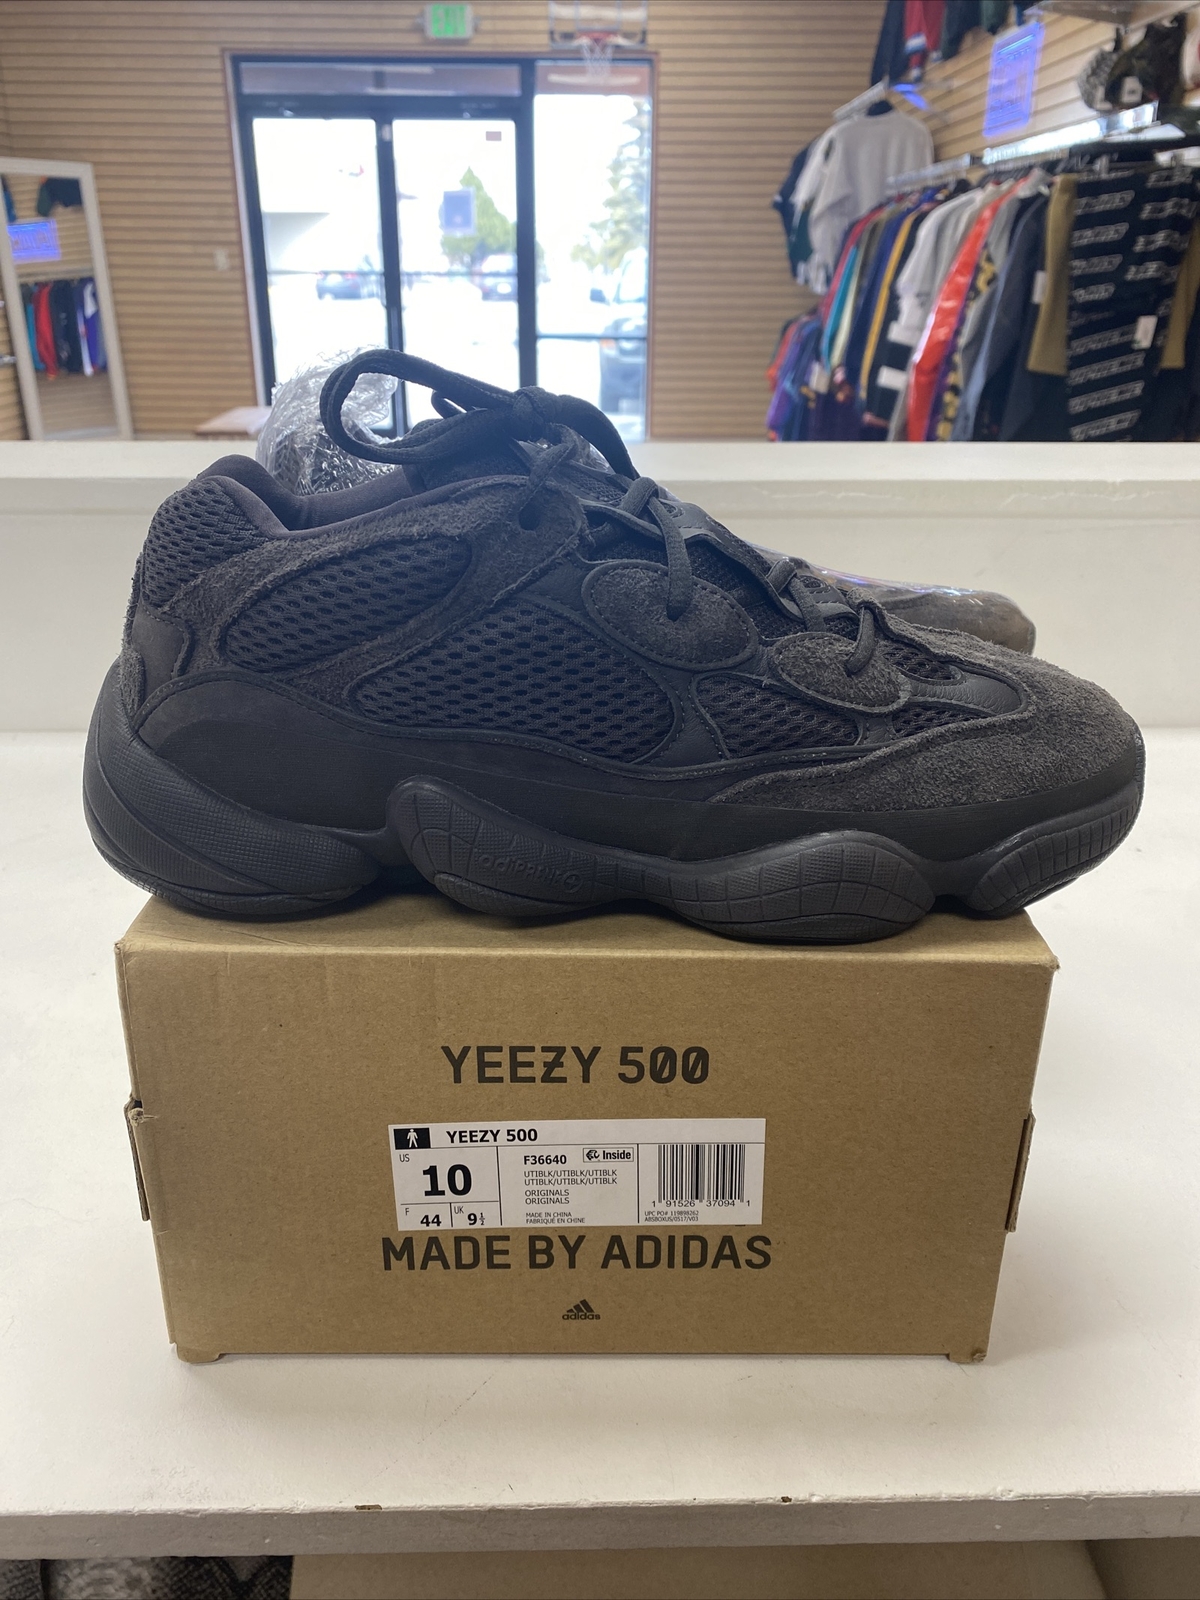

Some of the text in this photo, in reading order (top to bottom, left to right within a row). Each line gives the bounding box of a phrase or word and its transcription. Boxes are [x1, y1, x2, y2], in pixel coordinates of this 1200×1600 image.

[441, 1044, 709, 1084] YEEZY 500
[446, 1129, 537, 1143] YEEZY 500
[399, 1153, 410, 1163] US
[602, 1149, 632, 1160] Inside
[524, 1155, 566, 1165] F36640
[523, 1169, 618, 1178] UTIBLK/UTIBLK/UTIBLK
[423, 1164, 471, 1196] 10
[524, 1177, 618, 1186] UTIBLK/UTIBLK/UTIBLK
[524, 1189, 570, 1197] ORIGINALS
[524, 1197, 570, 1205] ORIGINALS
[665, 1200, 696, 1208] 91526
[705, 1199, 736, 1207] 37094
[453, 1205, 465, 1215] UK
[404, 1207, 441, 1226] F 44
[382, 1235, 771, 1270] MADE BY ADIDAS
[562, 1312, 601, 1321] adidas
